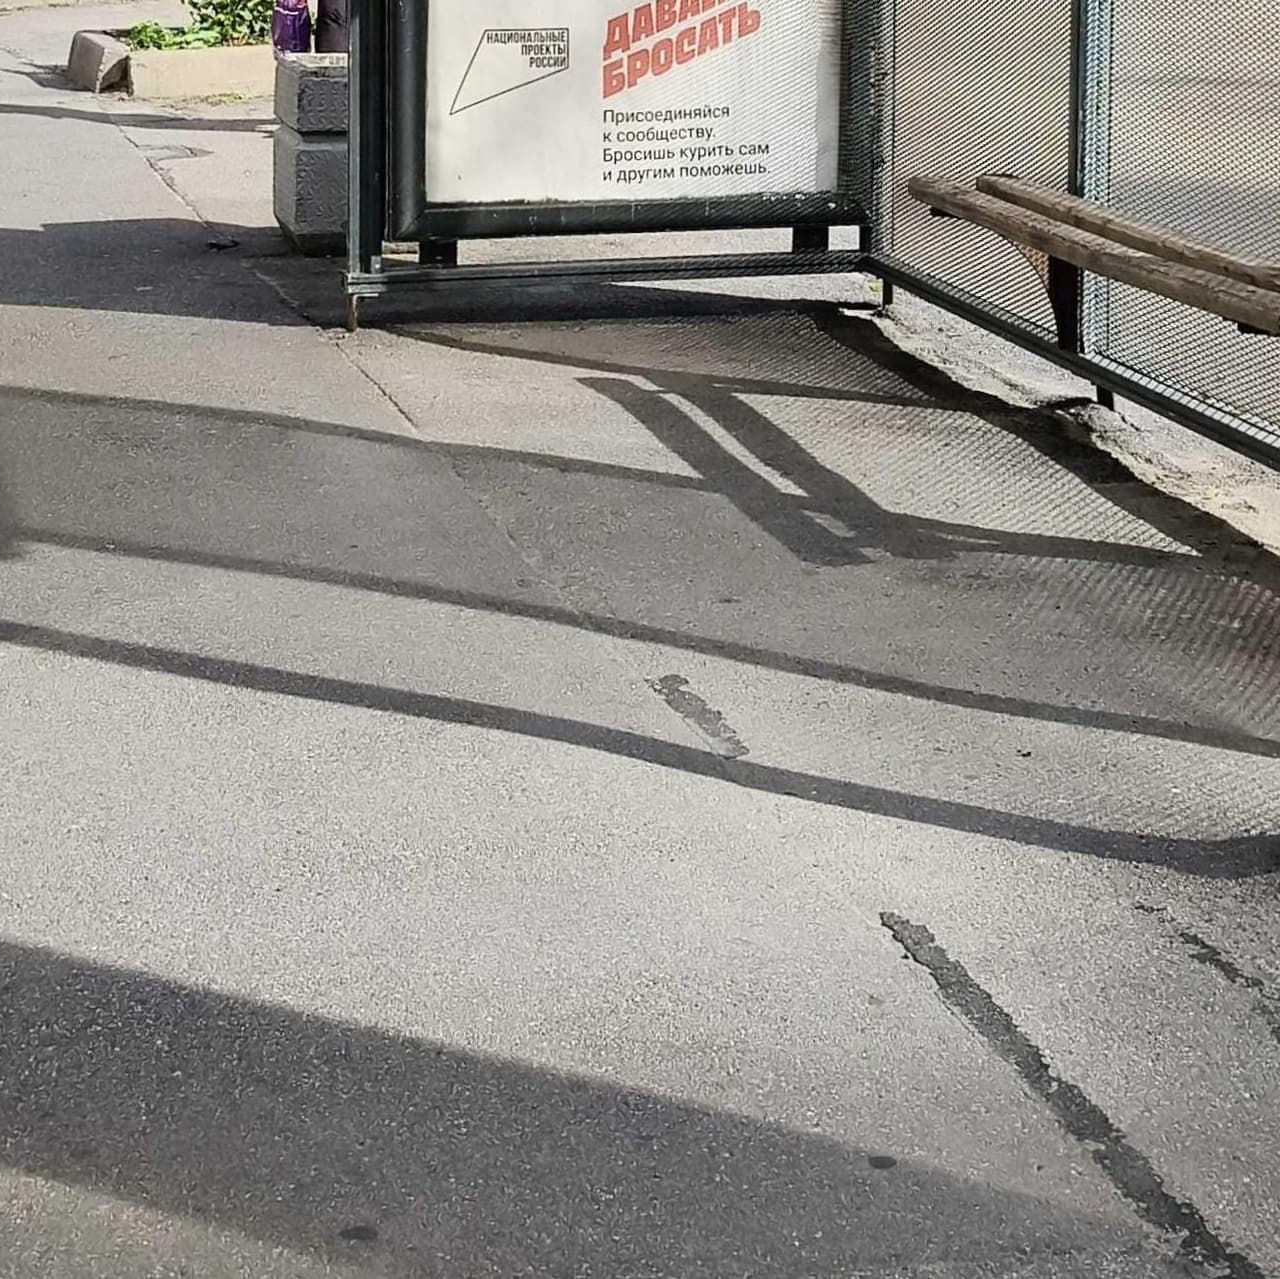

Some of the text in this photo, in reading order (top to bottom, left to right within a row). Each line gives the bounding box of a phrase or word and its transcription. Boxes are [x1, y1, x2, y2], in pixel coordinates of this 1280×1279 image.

[486, 31, 566, 45] НАЦИОНАЛЬНЫЕ
[521, 43, 566, 56] ПРОЕКТЫ
[603, 1, 761, 99] БРОСАТЬ
[529, 56, 566, 68] РОССИИ
[603, 105, 730, 126] Присоединяйся
[603, 126, 716, 143] к сообществу.
[603, 143, 770, 165] Бросишь курить сам
[603, 162, 771, 185] и другим поможешь.
